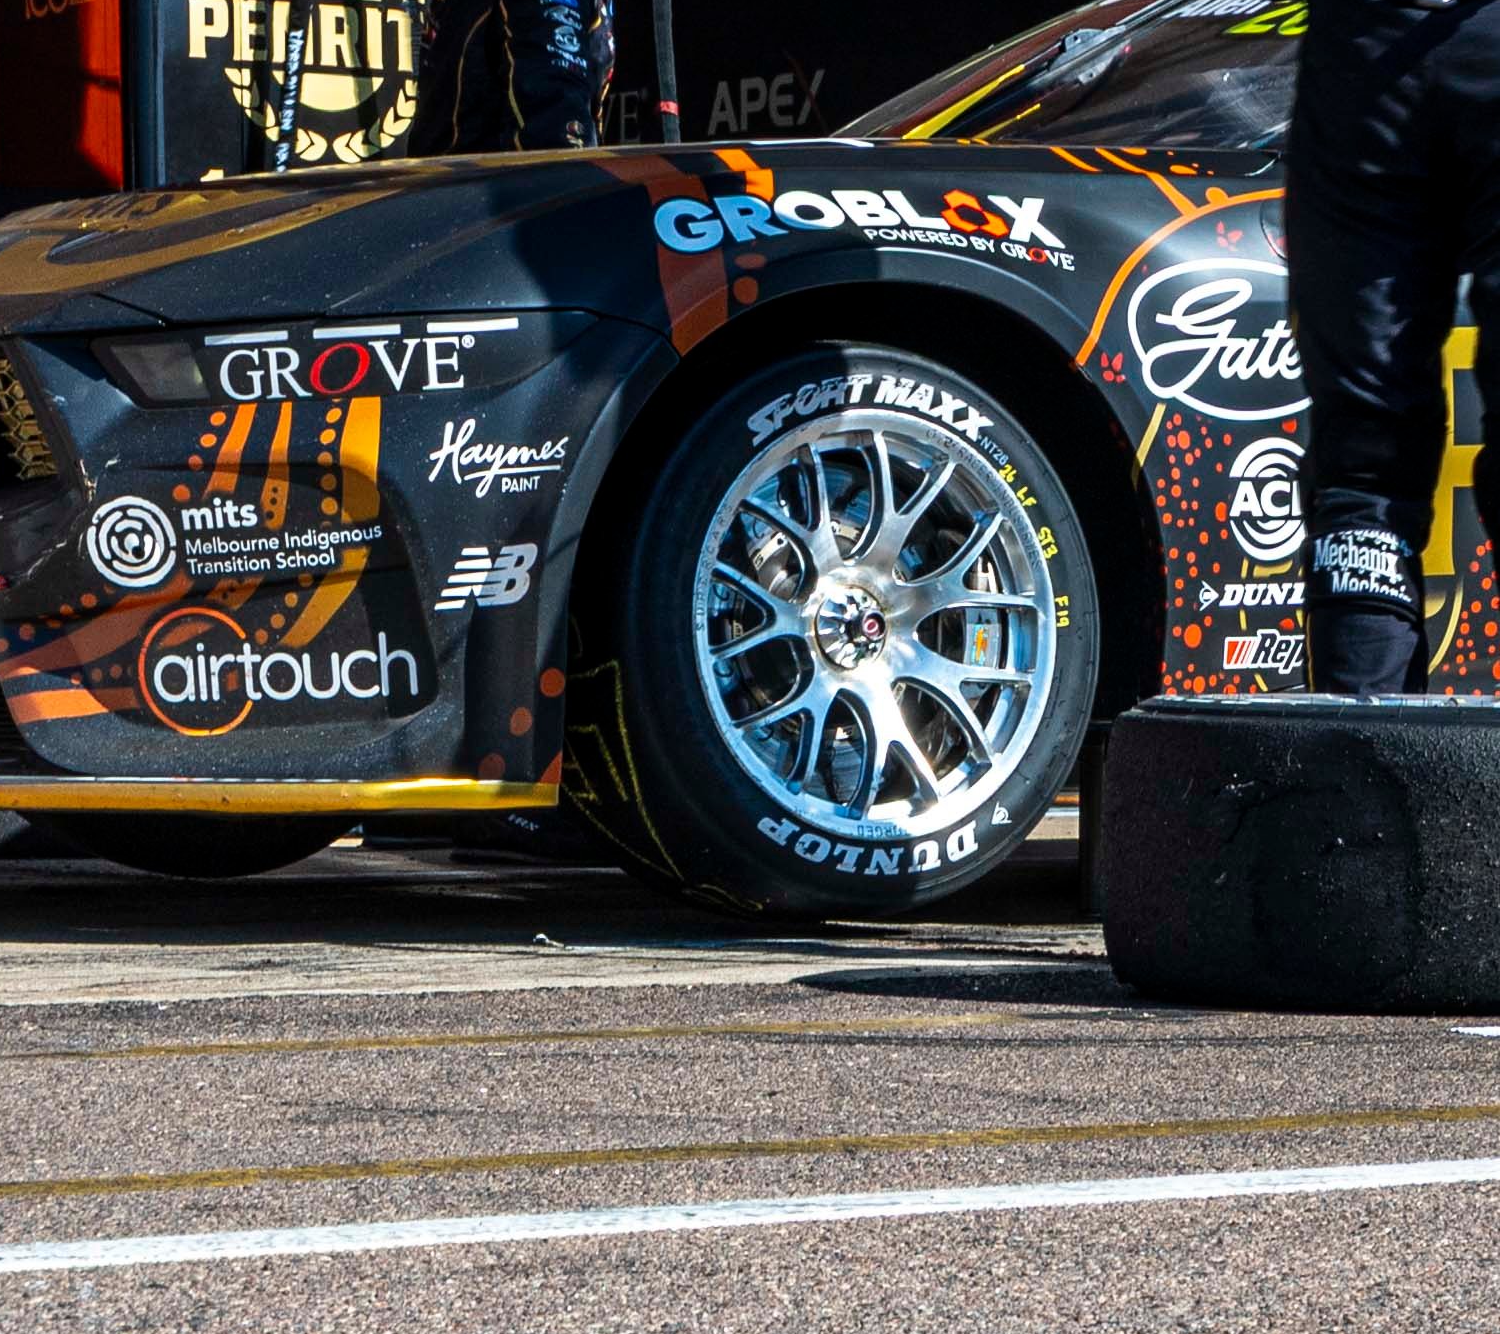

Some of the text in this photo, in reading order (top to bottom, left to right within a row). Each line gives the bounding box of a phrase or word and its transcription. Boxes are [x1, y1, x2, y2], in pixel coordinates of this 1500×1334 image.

[653, 188, 1067, 256] GROBLOX
[863, 227, 1076, 271] POWERED BY GROVE
[1148, 277, 1304, 395] Gate
[745, 372, 995, 447] SPORT MAXX
[427, 417, 571, 499] Haymes
[501, 474, 542, 495] PAINT
[998, 463, 1017, 484] 26
[1016, 485, 1038, 508] LF
[181, 498, 258, 531] mits
[185, 521, 383, 558] Melbourne Indigenous
[187, 546, 336, 577] Transition School
[151, 631, 421, 705] airtouch
[756, 816, 980, 876] DUNLOP
